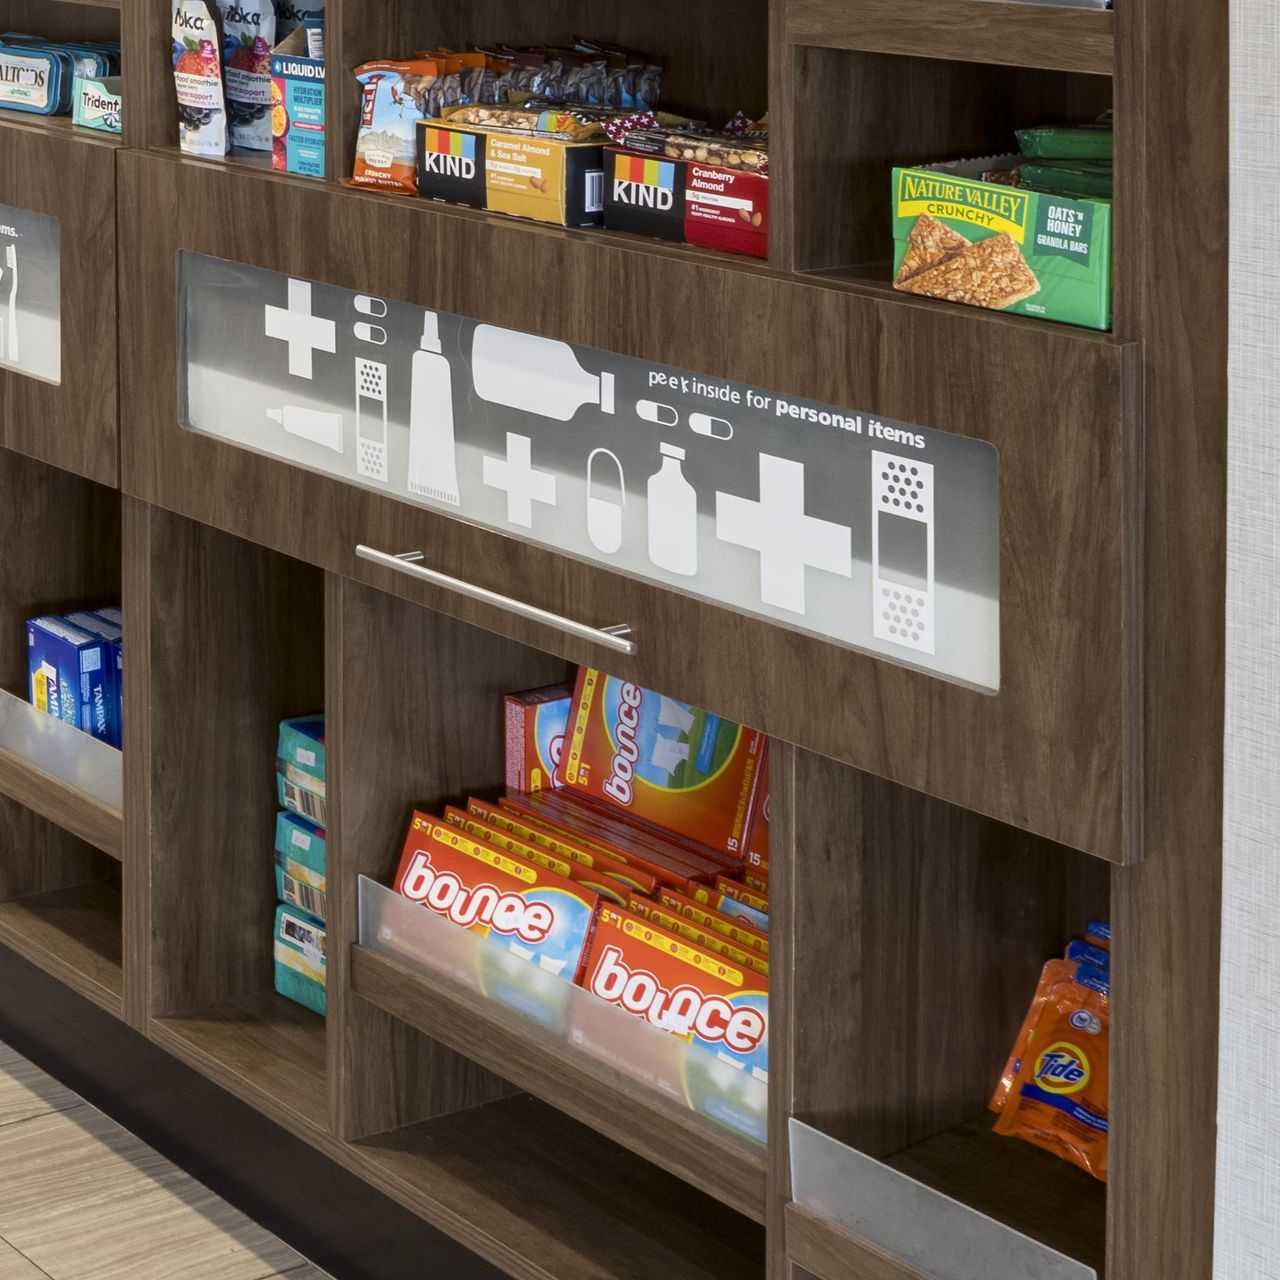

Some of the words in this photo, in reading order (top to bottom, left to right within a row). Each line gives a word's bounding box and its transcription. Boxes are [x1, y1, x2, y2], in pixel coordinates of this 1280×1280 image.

[283, 63, 312, 76] LIQUID
[82, 91, 119, 112] Trident
[294, 87, 322, 97] HYDRATION
[294, 96, 323, 105] MULTIPLIER
[490, 149, 496, 157] &
[497, 150, 511, 160] Sea
[512, 152, 527, 162] Salt
[491, 139, 520, 150] Caramel
[522, 144, 550, 156] Almond
[425, 151, 475, 180] KIND
[692, 167, 735, 184] Cranberry
[613, 179, 673, 211] KIND
[692, 179, 724, 192] Almond
[904, 176, 962, 202] NATURE
[966, 187, 1022, 221] VALLEY
[927, 203, 995, 226] CRUNCHY
[1048, 206, 1074, 222] OATS
[1047, 220, 1082, 237] HONEY
[1037, 234, 1068, 251] GRANOLA
[1070, 240, 1088, 254] BARS
[649, 371, 689, 393] peek
[692, 378, 740, 404] inside
[747, 390, 771, 409] for
[776, 398, 861, 434] personal
[869, 420, 926, 449] items
[94, 684, 106, 734] TAMPAX
[604, 681, 641, 805] bounce
[1037, 1052, 1085, 1083] Tide
